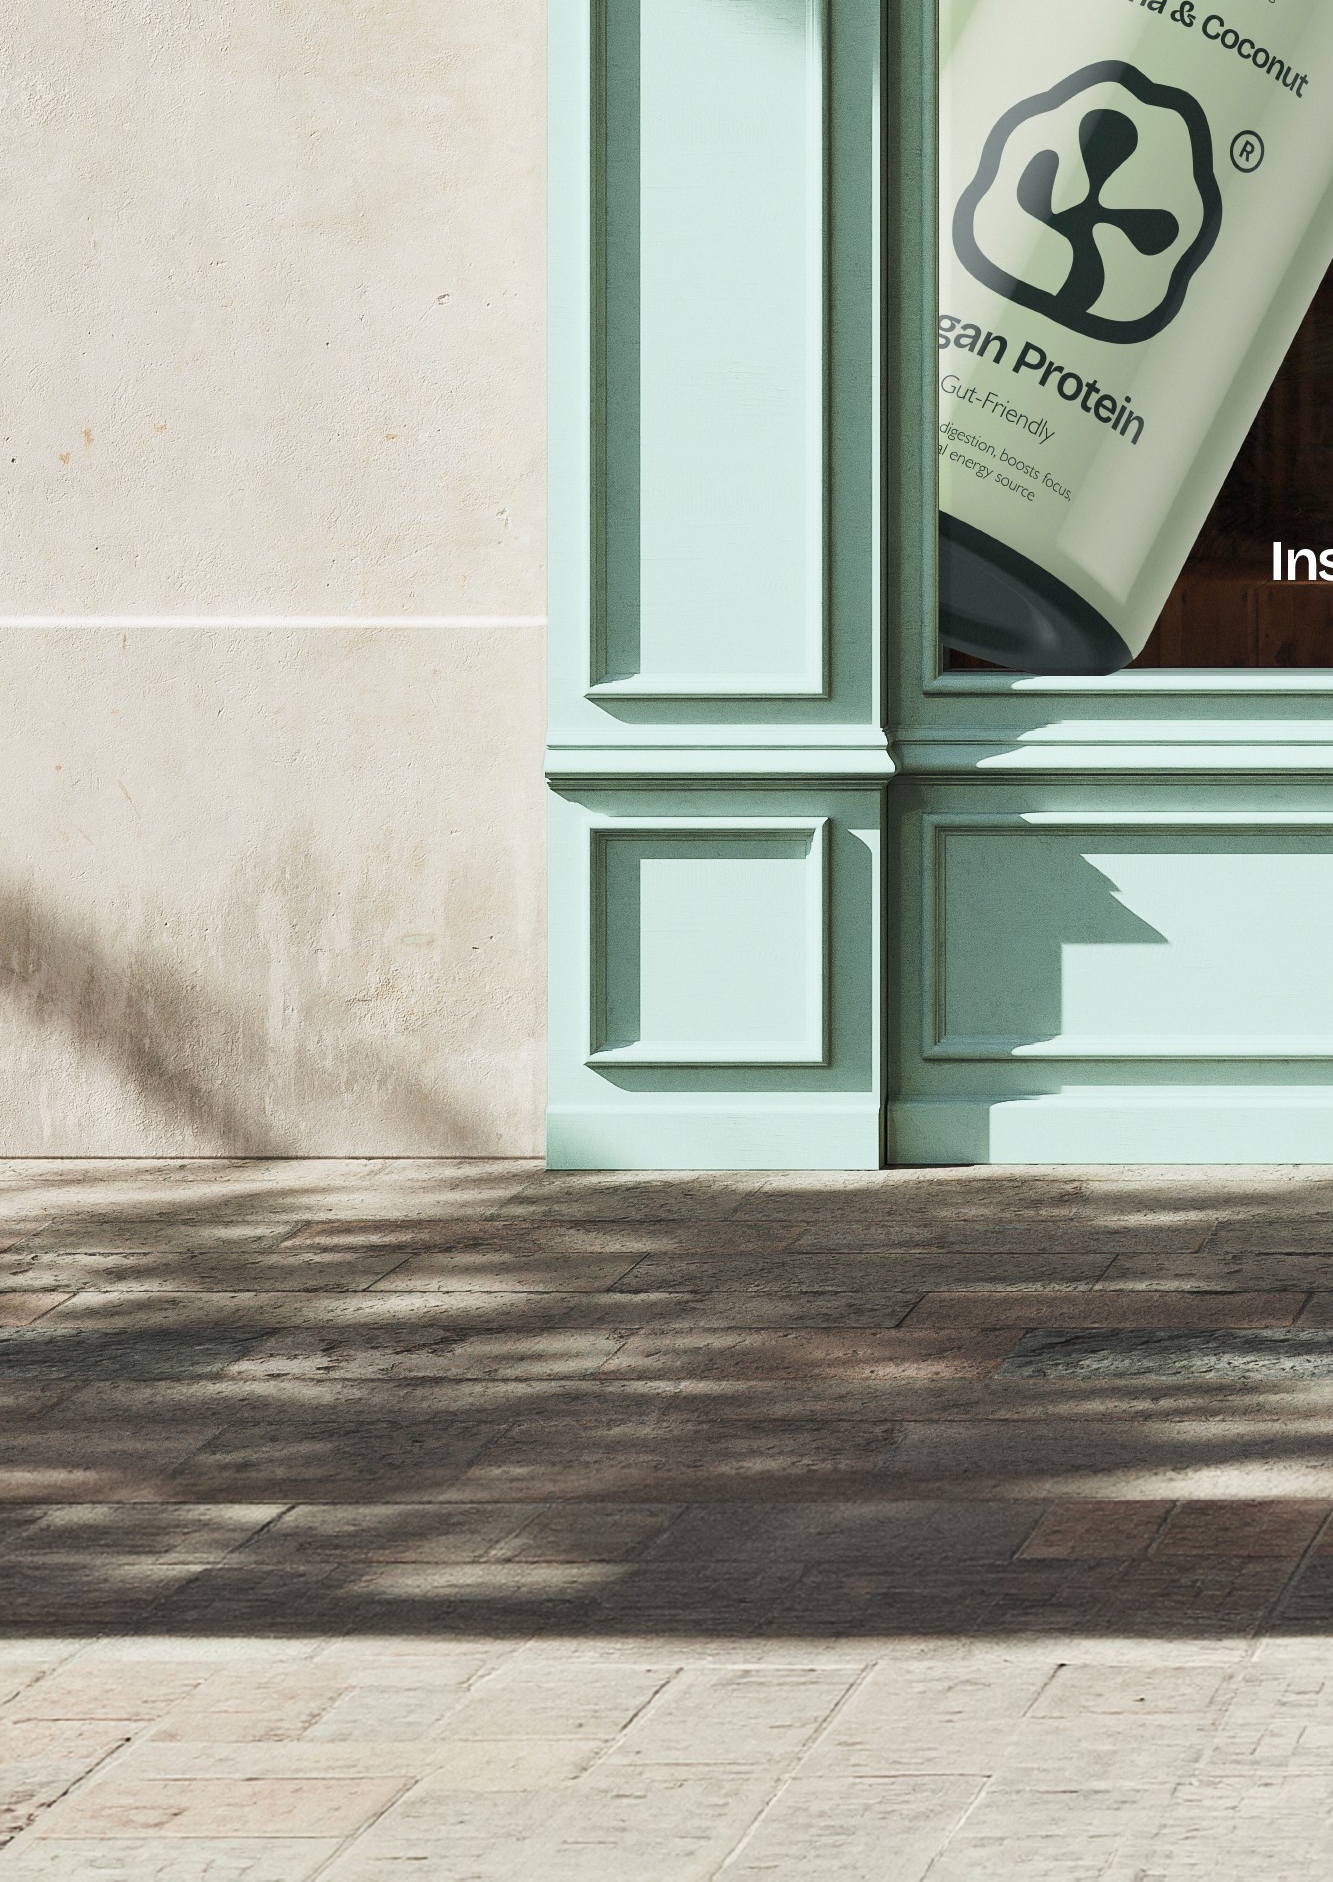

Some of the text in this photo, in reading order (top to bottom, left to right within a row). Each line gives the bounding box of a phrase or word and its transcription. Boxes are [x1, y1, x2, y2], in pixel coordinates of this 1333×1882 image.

[1170, 0, 1197, 28] &
[1201, 14, 1309, 99] Coconut
[940, 374, 1056, 445] Gut-Friendly
[1011, 340, 1145, 446] Protein
[939, 421, 1072, 503] digestion, boosts focus,
[949, 451, 994, 479] energy
[994, 473, 1035, 502] source
